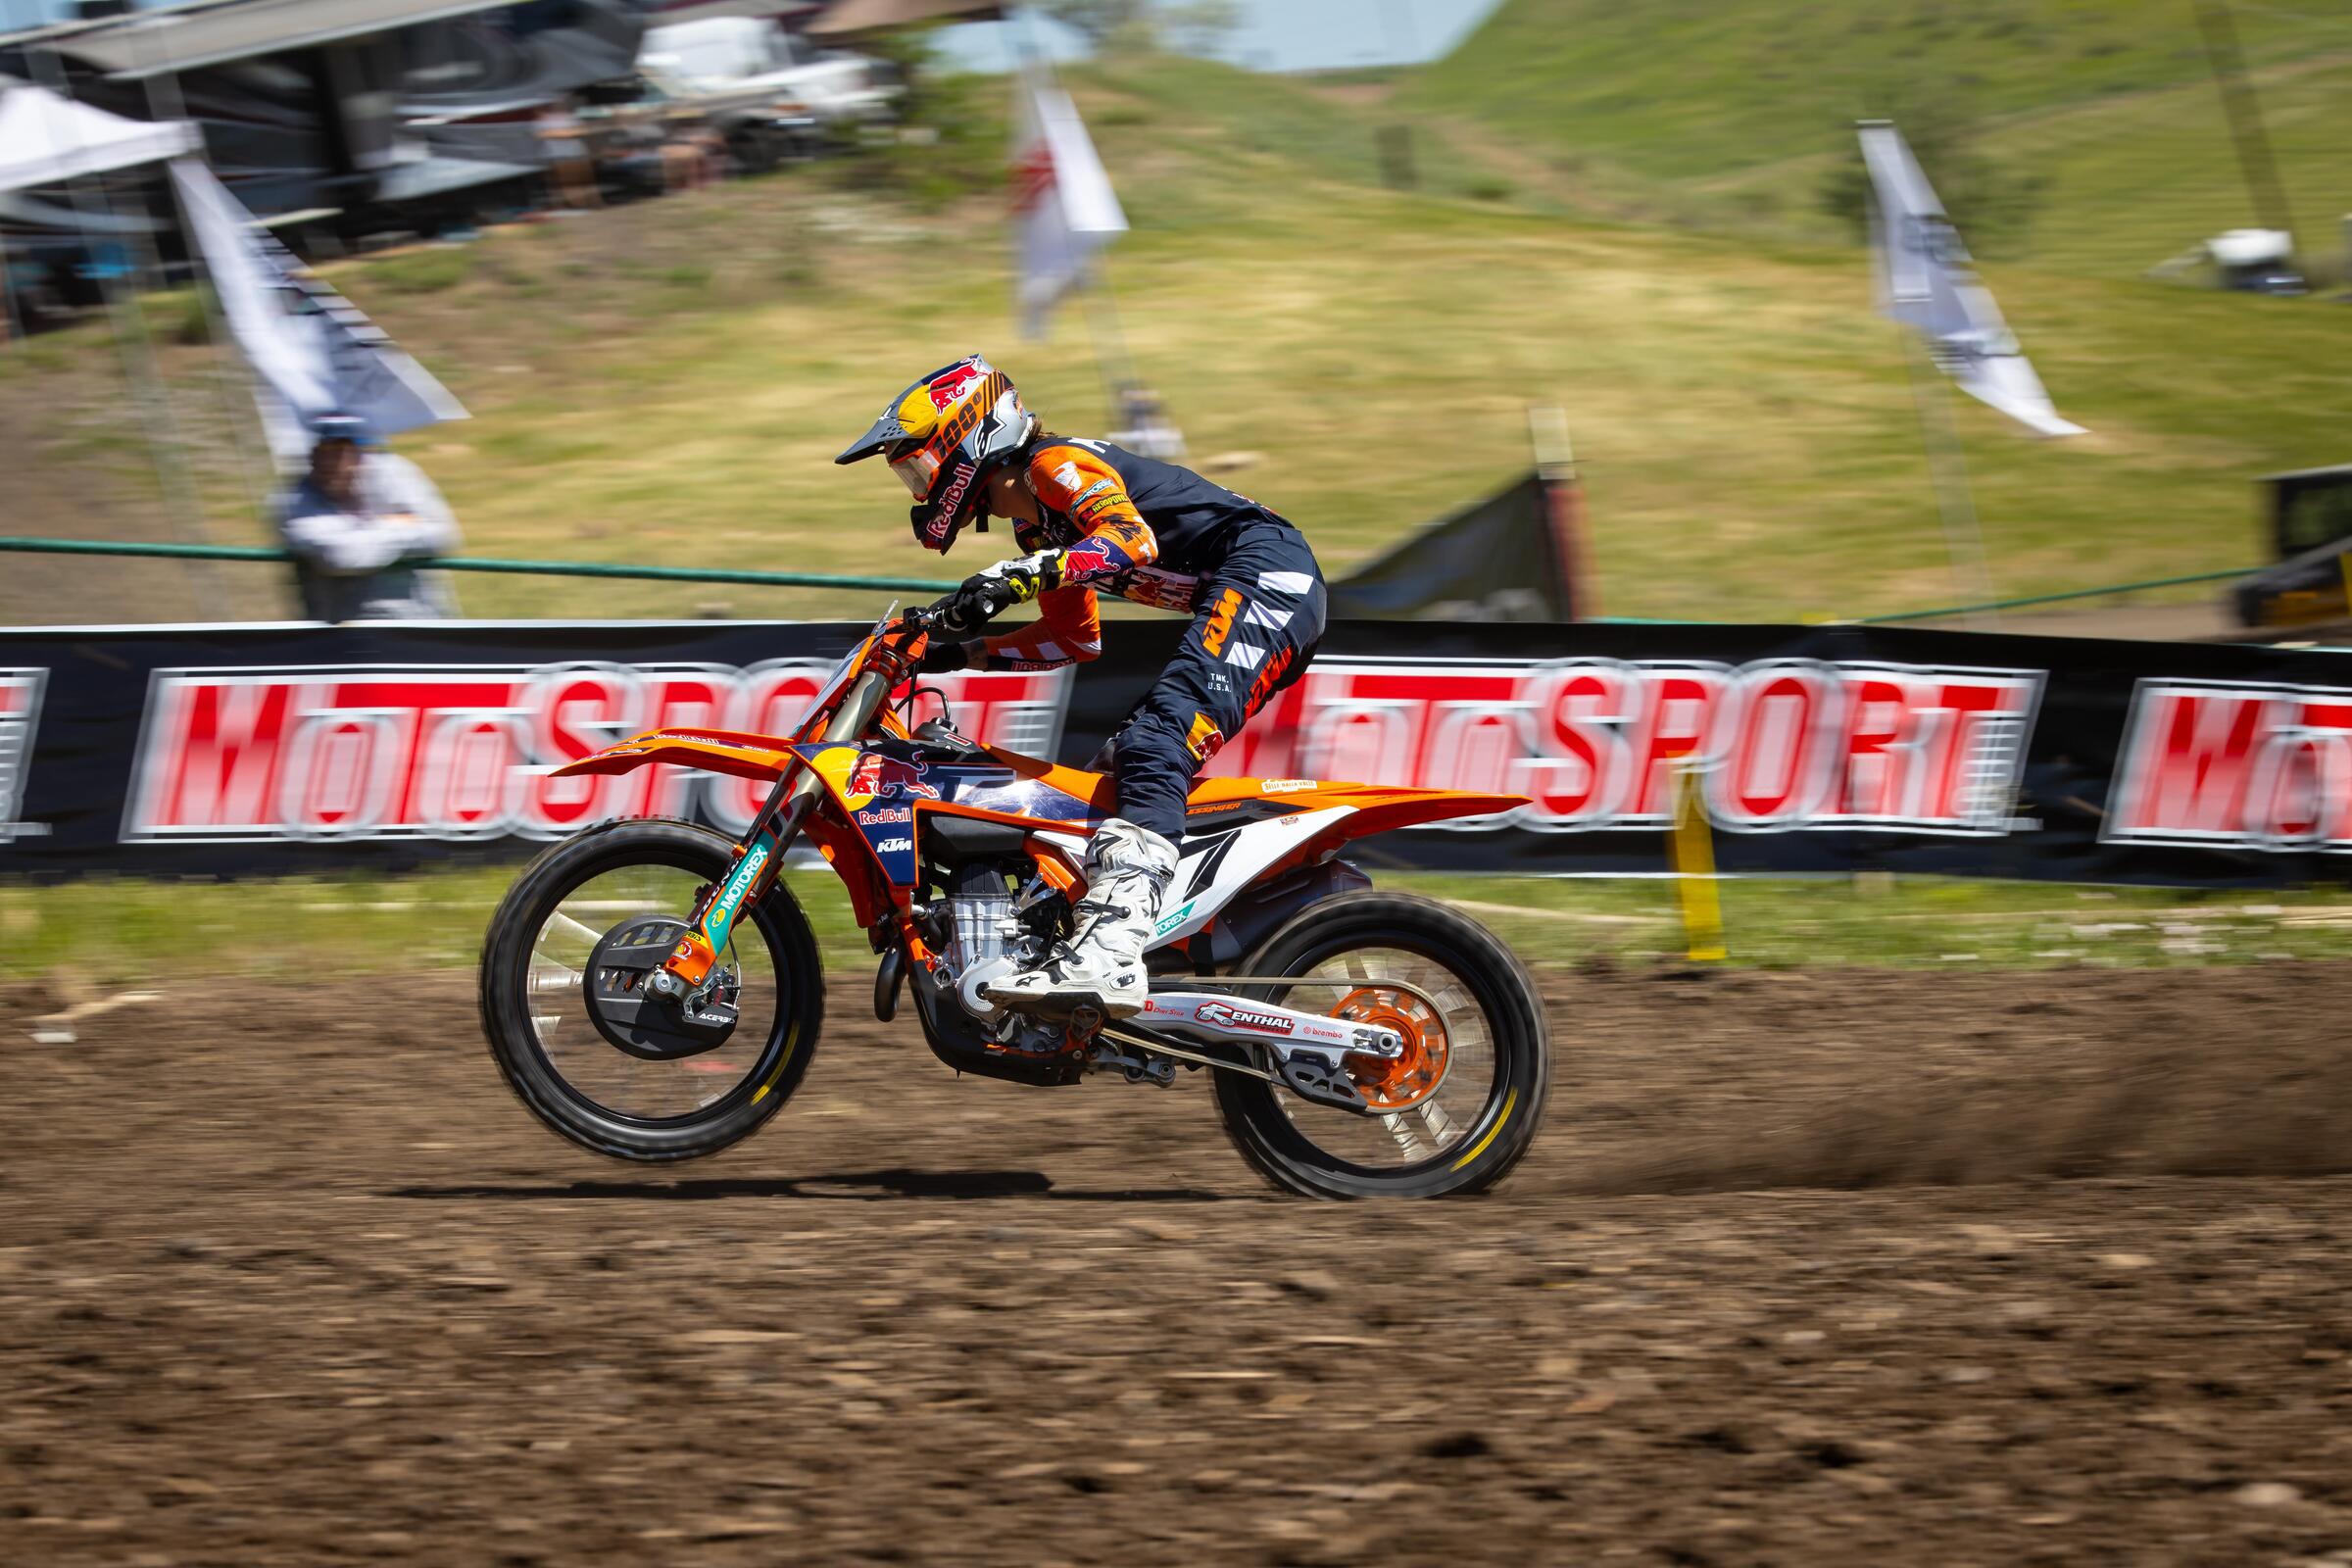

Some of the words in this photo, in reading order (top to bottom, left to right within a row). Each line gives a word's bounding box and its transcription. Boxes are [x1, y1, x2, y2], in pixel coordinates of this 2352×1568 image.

[1202, 587, 1244, 658] KTM
[1207, 681, 1232, 693] U.S.A.
[120, 661, 1070, 845] MOTOSPT
[1186, 802, 1242, 815] ESSINGER
[876, 838, 911, 853] KTM
[720, 846, 768, 911] MOTOREX
[1156, 910, 1189, 934] TOREX
[1197, 1004, 1293, 1028] RENTHAL
[1313, 1027, 1343, 1039] brembo
